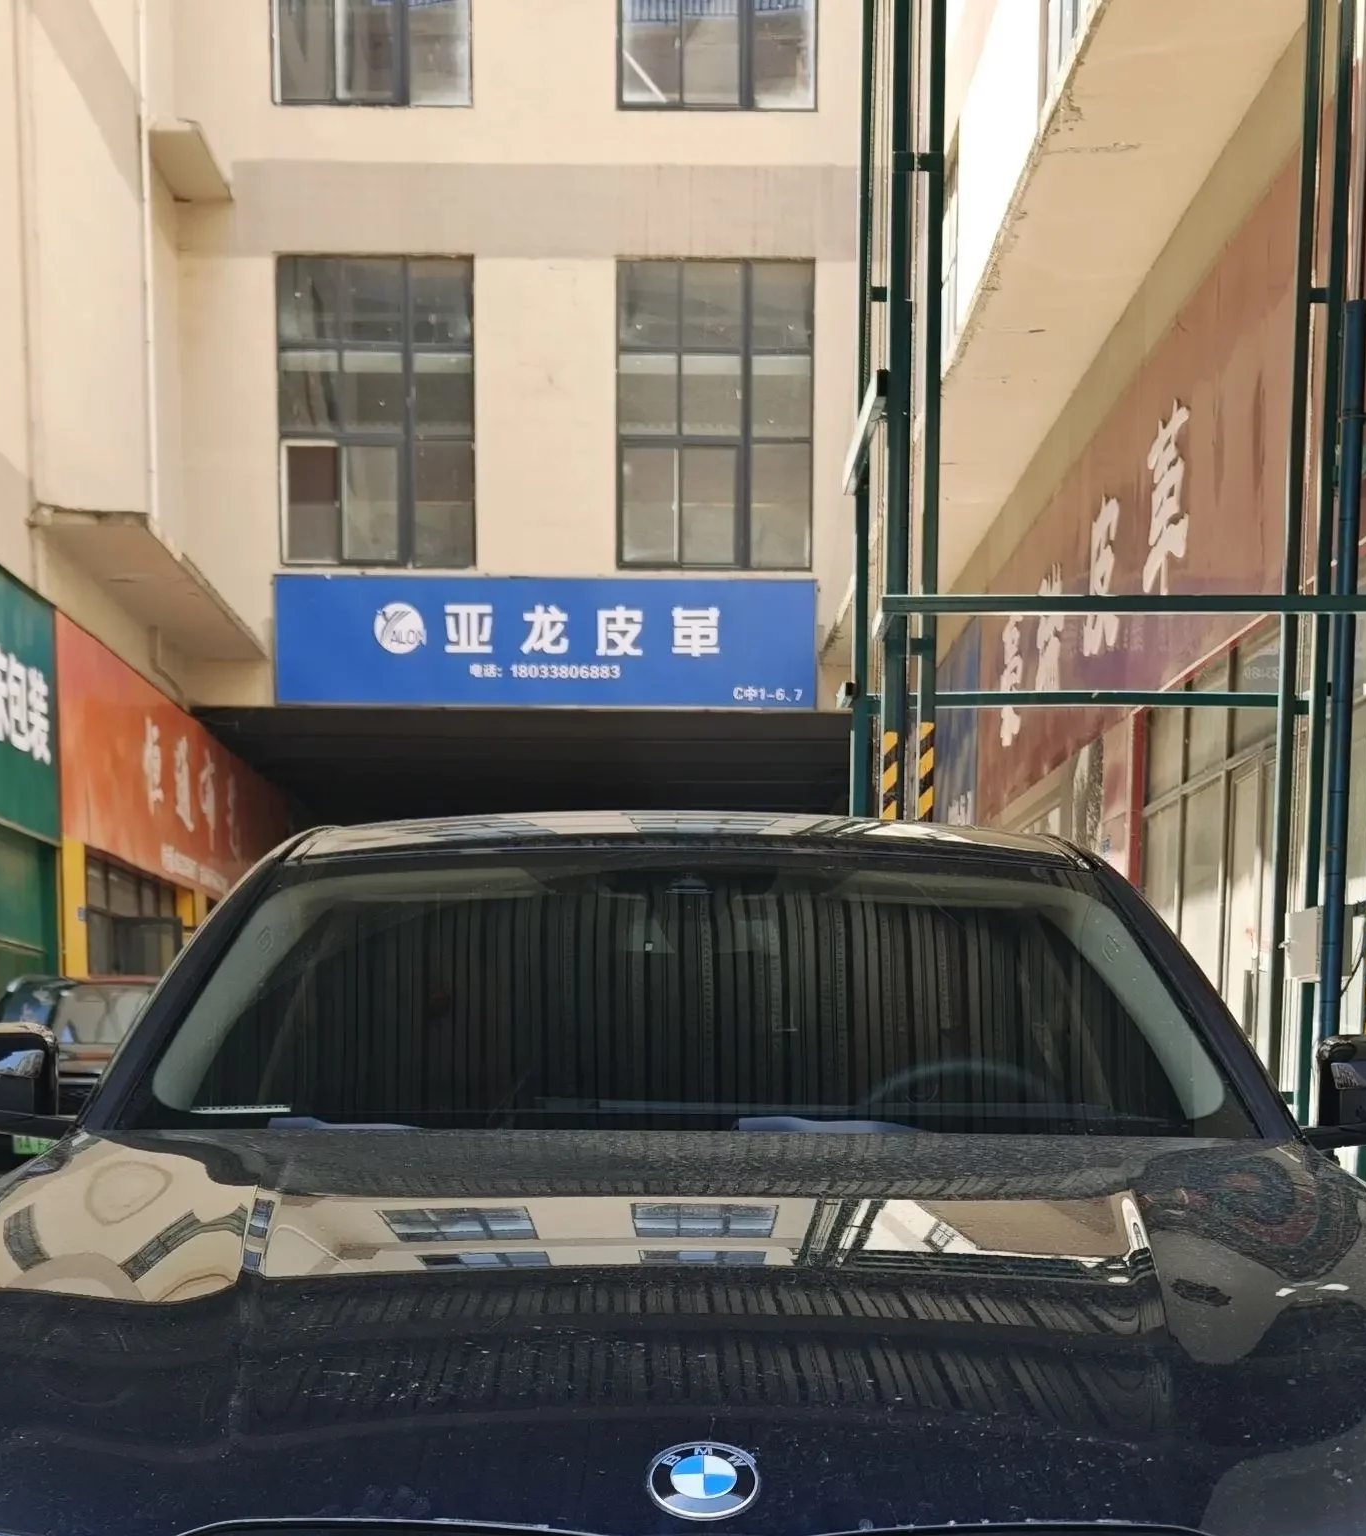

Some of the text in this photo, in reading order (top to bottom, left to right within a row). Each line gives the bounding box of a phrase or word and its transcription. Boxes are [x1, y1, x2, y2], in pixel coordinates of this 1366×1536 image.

[443, 604, 721, 656] 亚龙皮革
[661, 1446, 748, 1467] BMW
